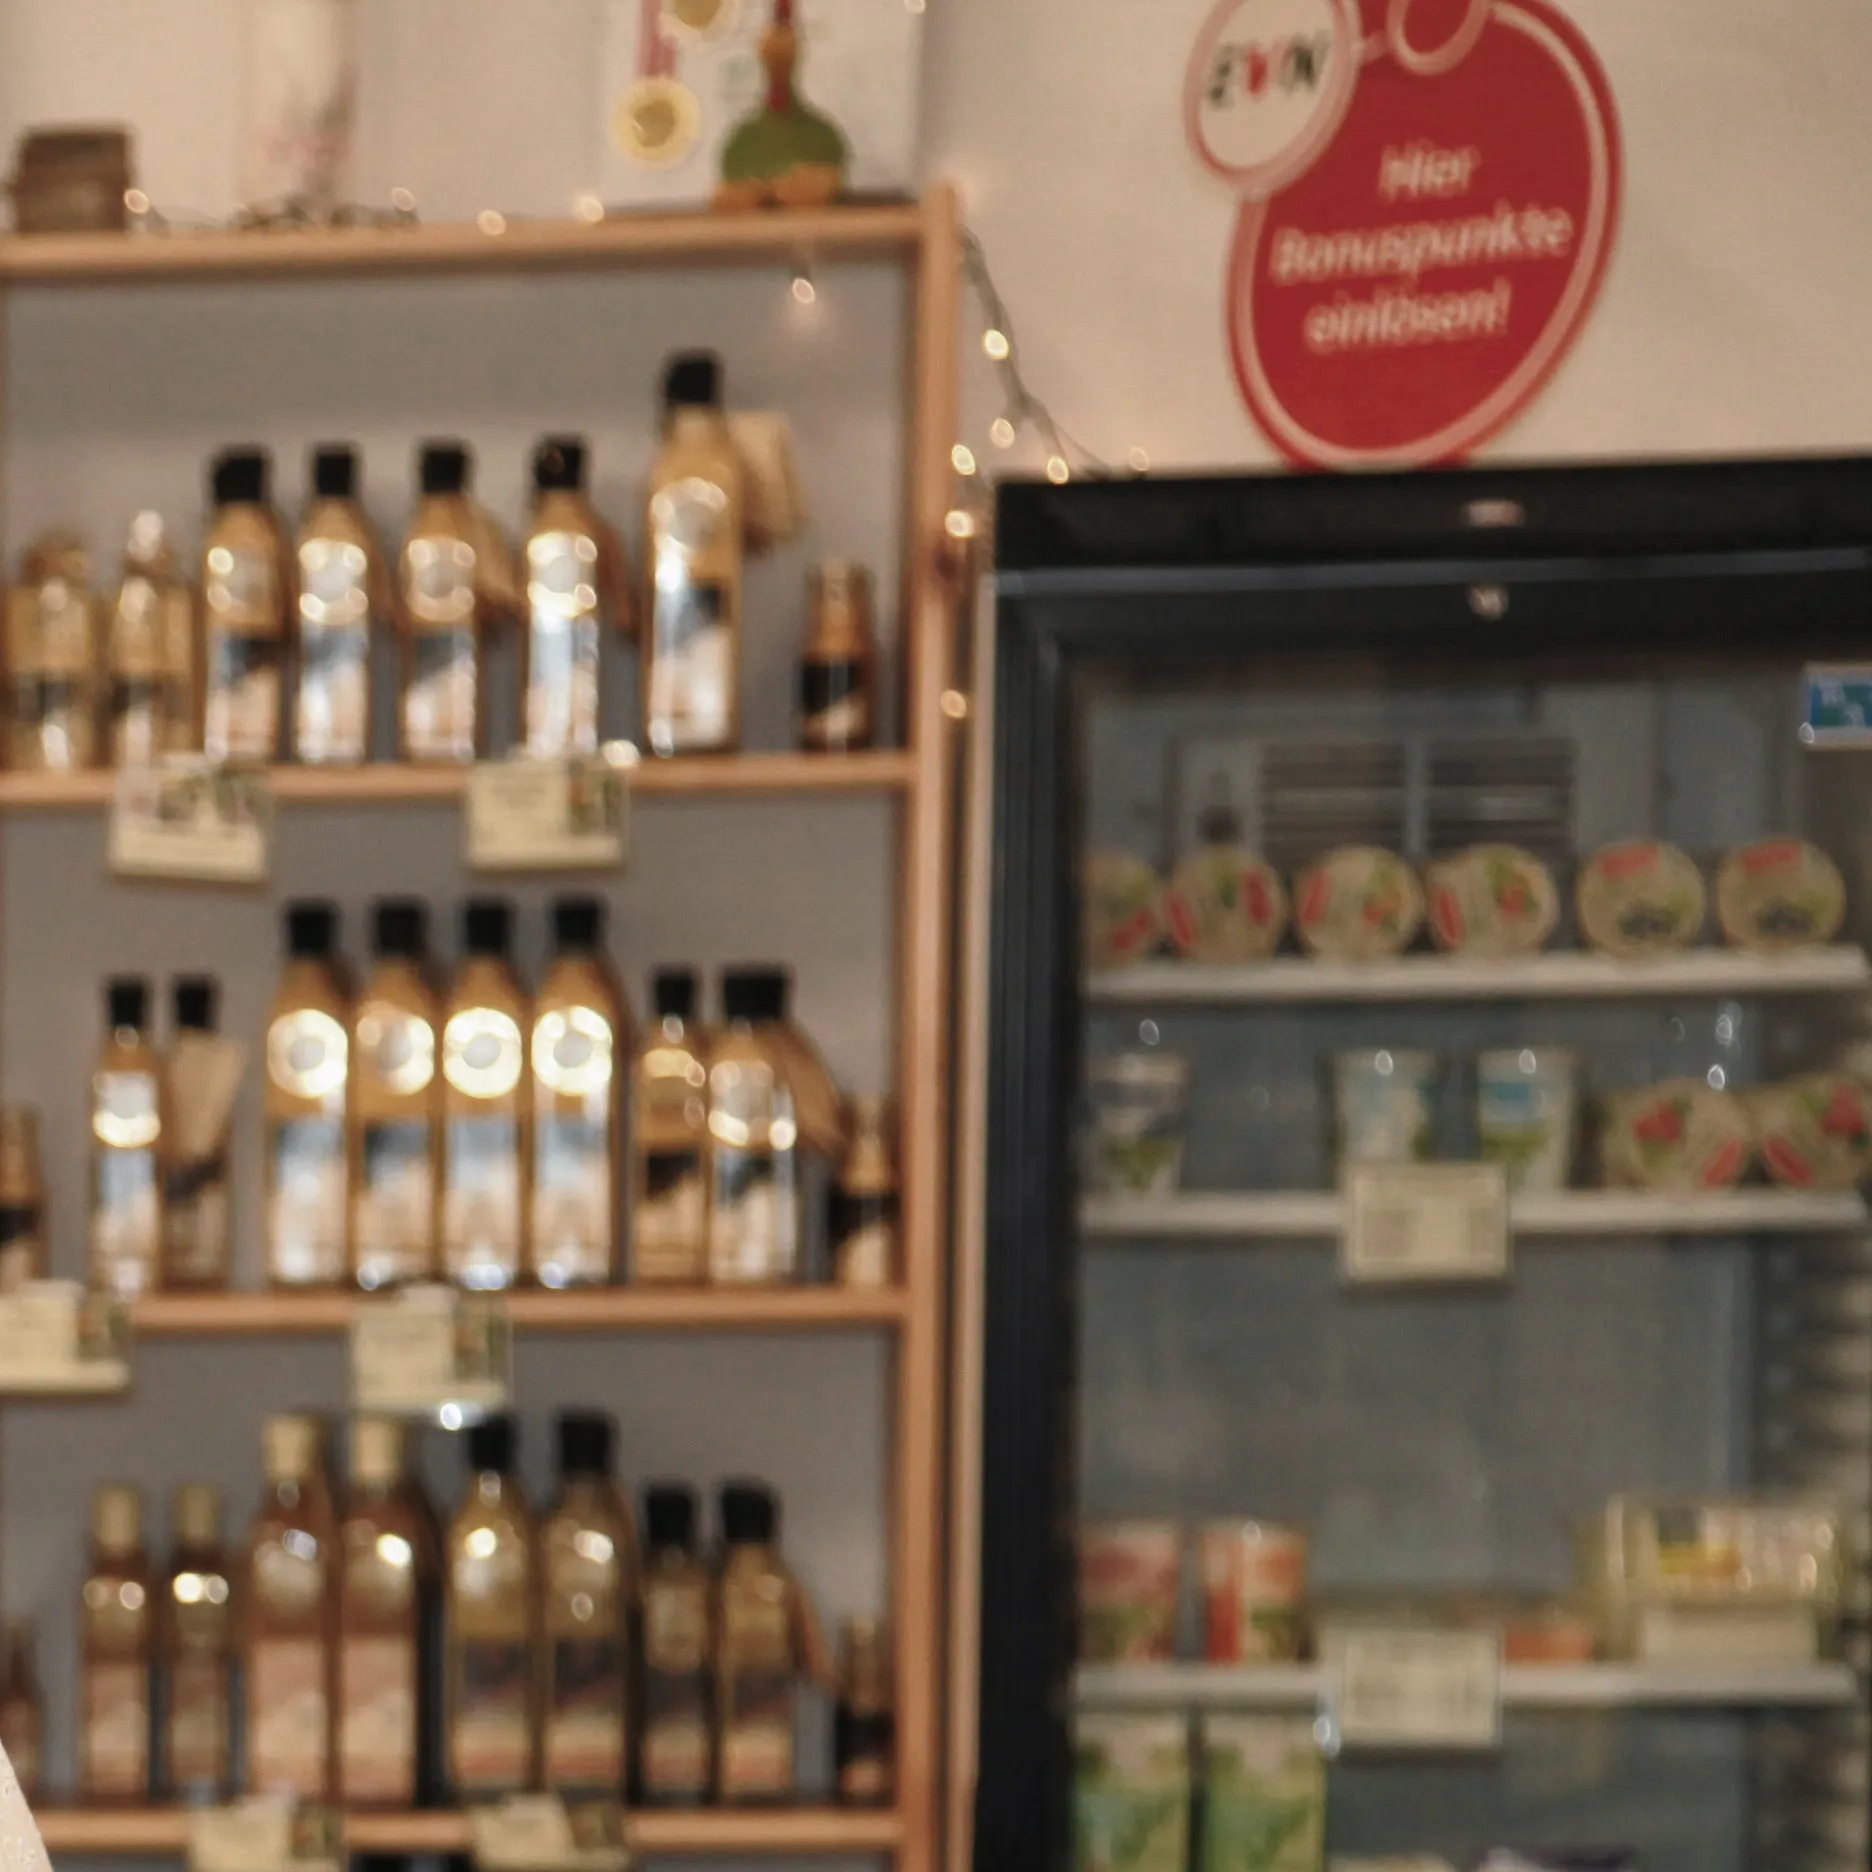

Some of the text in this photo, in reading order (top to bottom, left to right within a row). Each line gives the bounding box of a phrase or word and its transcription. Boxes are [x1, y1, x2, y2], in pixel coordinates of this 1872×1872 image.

[1380, 140, 1480, 200] Hier
[1269, 200, 1572, 285] Bonuspunkte
[1304, 278, 1511, 350] einlösen!
